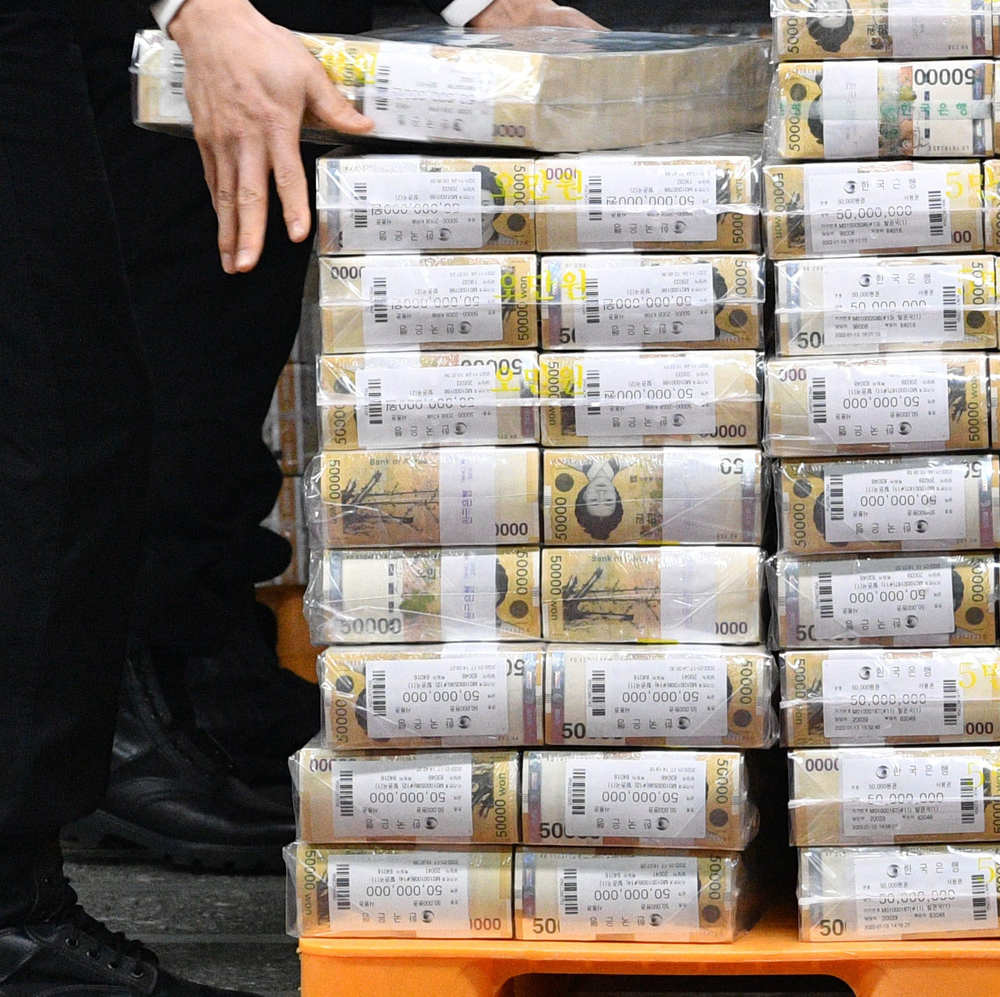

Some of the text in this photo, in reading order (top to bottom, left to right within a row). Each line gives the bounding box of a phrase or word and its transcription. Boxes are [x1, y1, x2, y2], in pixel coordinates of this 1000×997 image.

[914, 68, 975, 86] 50000
[520, 276, 528, 299] won
[843, 397, 920, 409] 50,000,000
[969, 402, 981, 441] 50000
[329, 460, 340, 500] 50000
[860, 494, 936, 506] 50,000,000
[555, 496, 567, 540] 50000
[794, 502, 806, 548] 50000
[517, 551, 528, 595] 50000
[550, 556, 561, 596] 50000
[849, 590, 927, 602] 50,000,000
[741, 660, 754, 704] 50000
[403, 690, 480, 703] 50,000,000
[622, 690, 699, 703] 50,000,000
[335, 698, 349, 743] 50000
[370, 792, 446, 803] 50,000,000
[495, 772, 508, 837] 50000 won
[602, 791, 679, 802] 50,000,000
[304, 850, 317, 890] 50000
[366, 885, 443, 897] 50,000,000
[595, 889, 671, 900] 50,000,000
